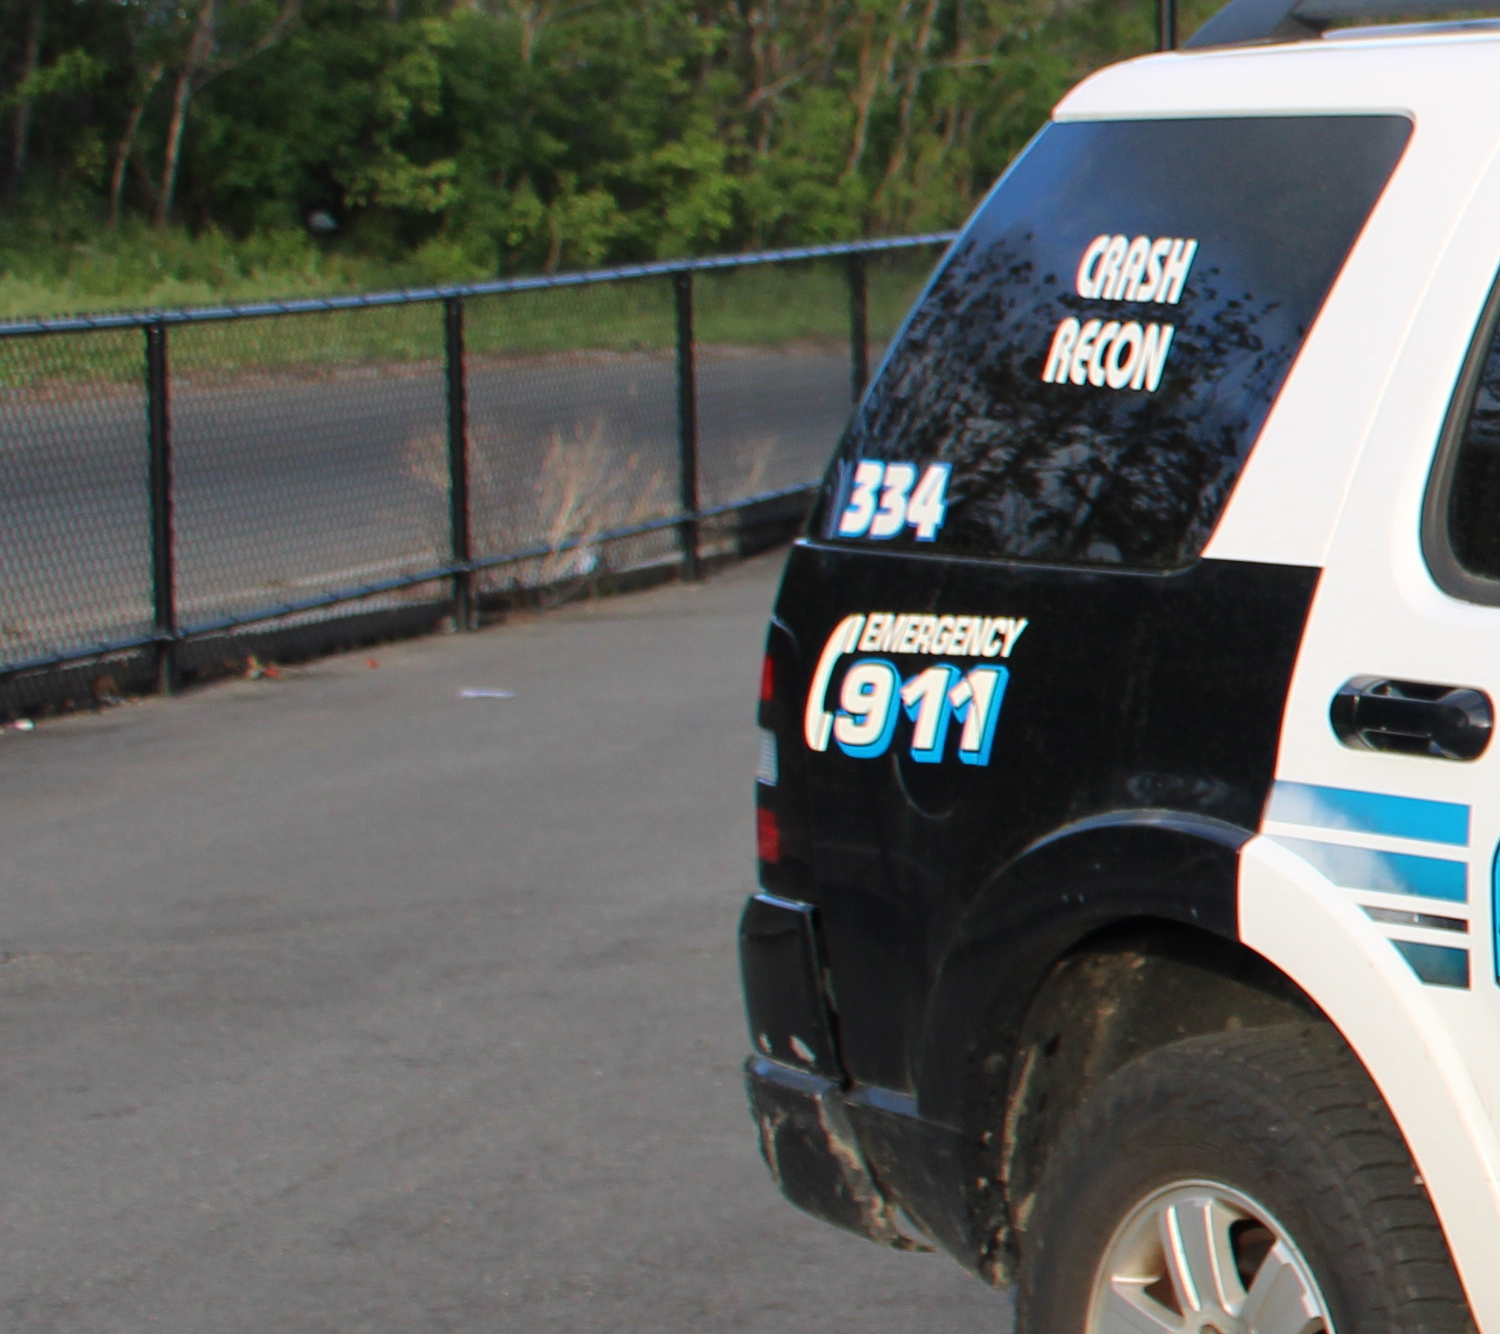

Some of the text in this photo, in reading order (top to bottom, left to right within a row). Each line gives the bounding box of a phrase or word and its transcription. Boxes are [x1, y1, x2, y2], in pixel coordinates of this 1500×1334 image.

[1076, 234, 1199, 305] CRASH
[1042, 317, 1175, 393] RECON
[839, 459, 953, 543] 334
[857, 611, 1029, 658] EMERGENCY
[833, 657, 1010, 767] 911
